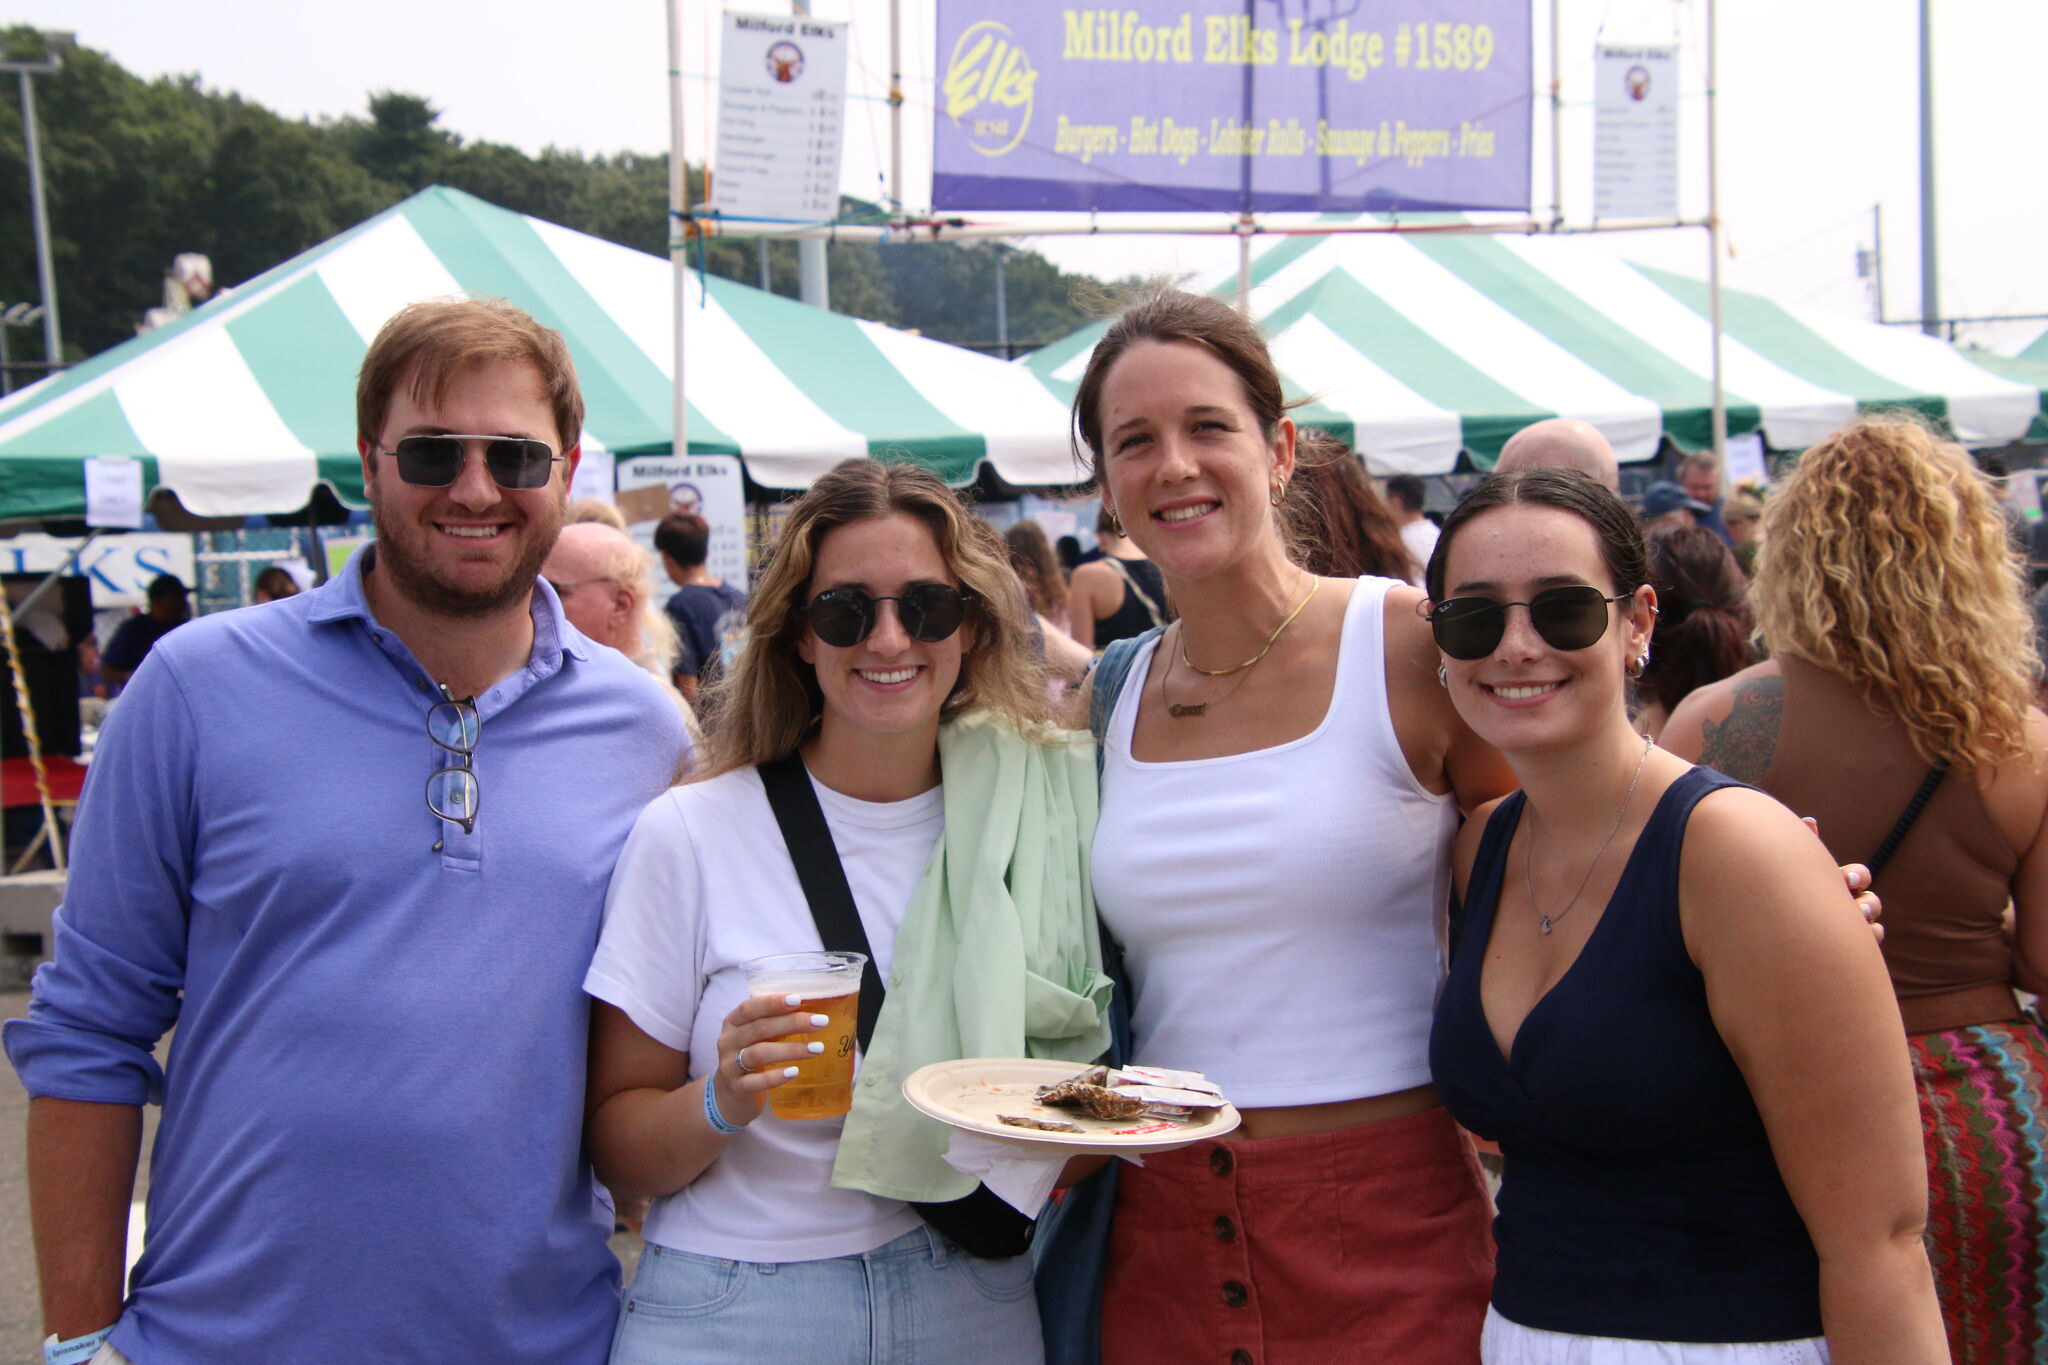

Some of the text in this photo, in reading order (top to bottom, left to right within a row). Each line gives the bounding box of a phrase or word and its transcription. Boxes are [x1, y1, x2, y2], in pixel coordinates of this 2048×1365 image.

[735, 16, 834, 38] Milford Elks
[1063, 9, 1494, 81] Milford Elks Lodge #1589
[944, 34, 1038, 117] Elks
[1055, 114, 1118, 164] Burgers
[1128, 116, 1158, 154] Hot
[1160, 116, 1198, 165] Dogs
[1392, 120, 1449, 167] Peppers
[1459, 121, 1495, 157] Fries
[632, 464, 727, 478] Milford Elks
